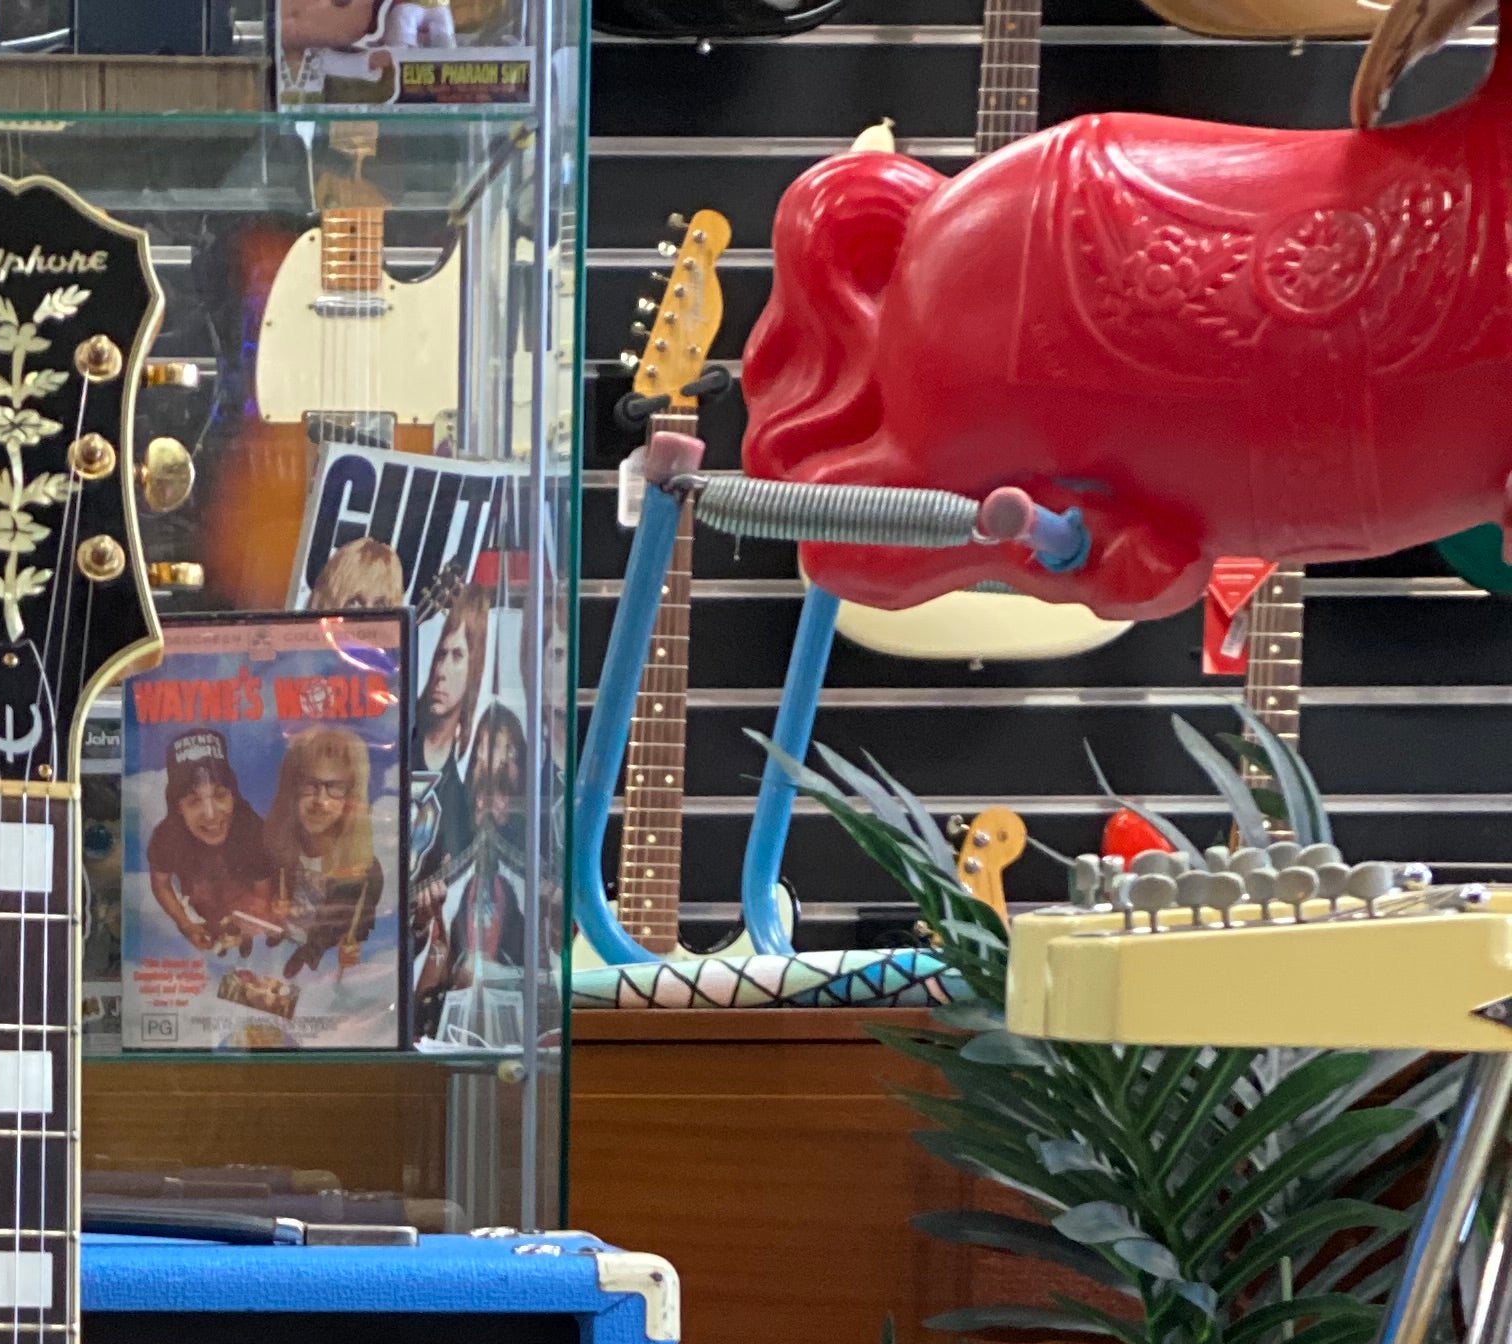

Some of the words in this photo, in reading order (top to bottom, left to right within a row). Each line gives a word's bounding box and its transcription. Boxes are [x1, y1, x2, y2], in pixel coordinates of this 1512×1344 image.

[403, 63, 436, 85] ELVIS
[133, 665, 264, 724] WAYNE'S
[274, 674, 390, 721] WORLD
[85, 730, 120, 746] John
[147, 1020, 173, 1036] PG
